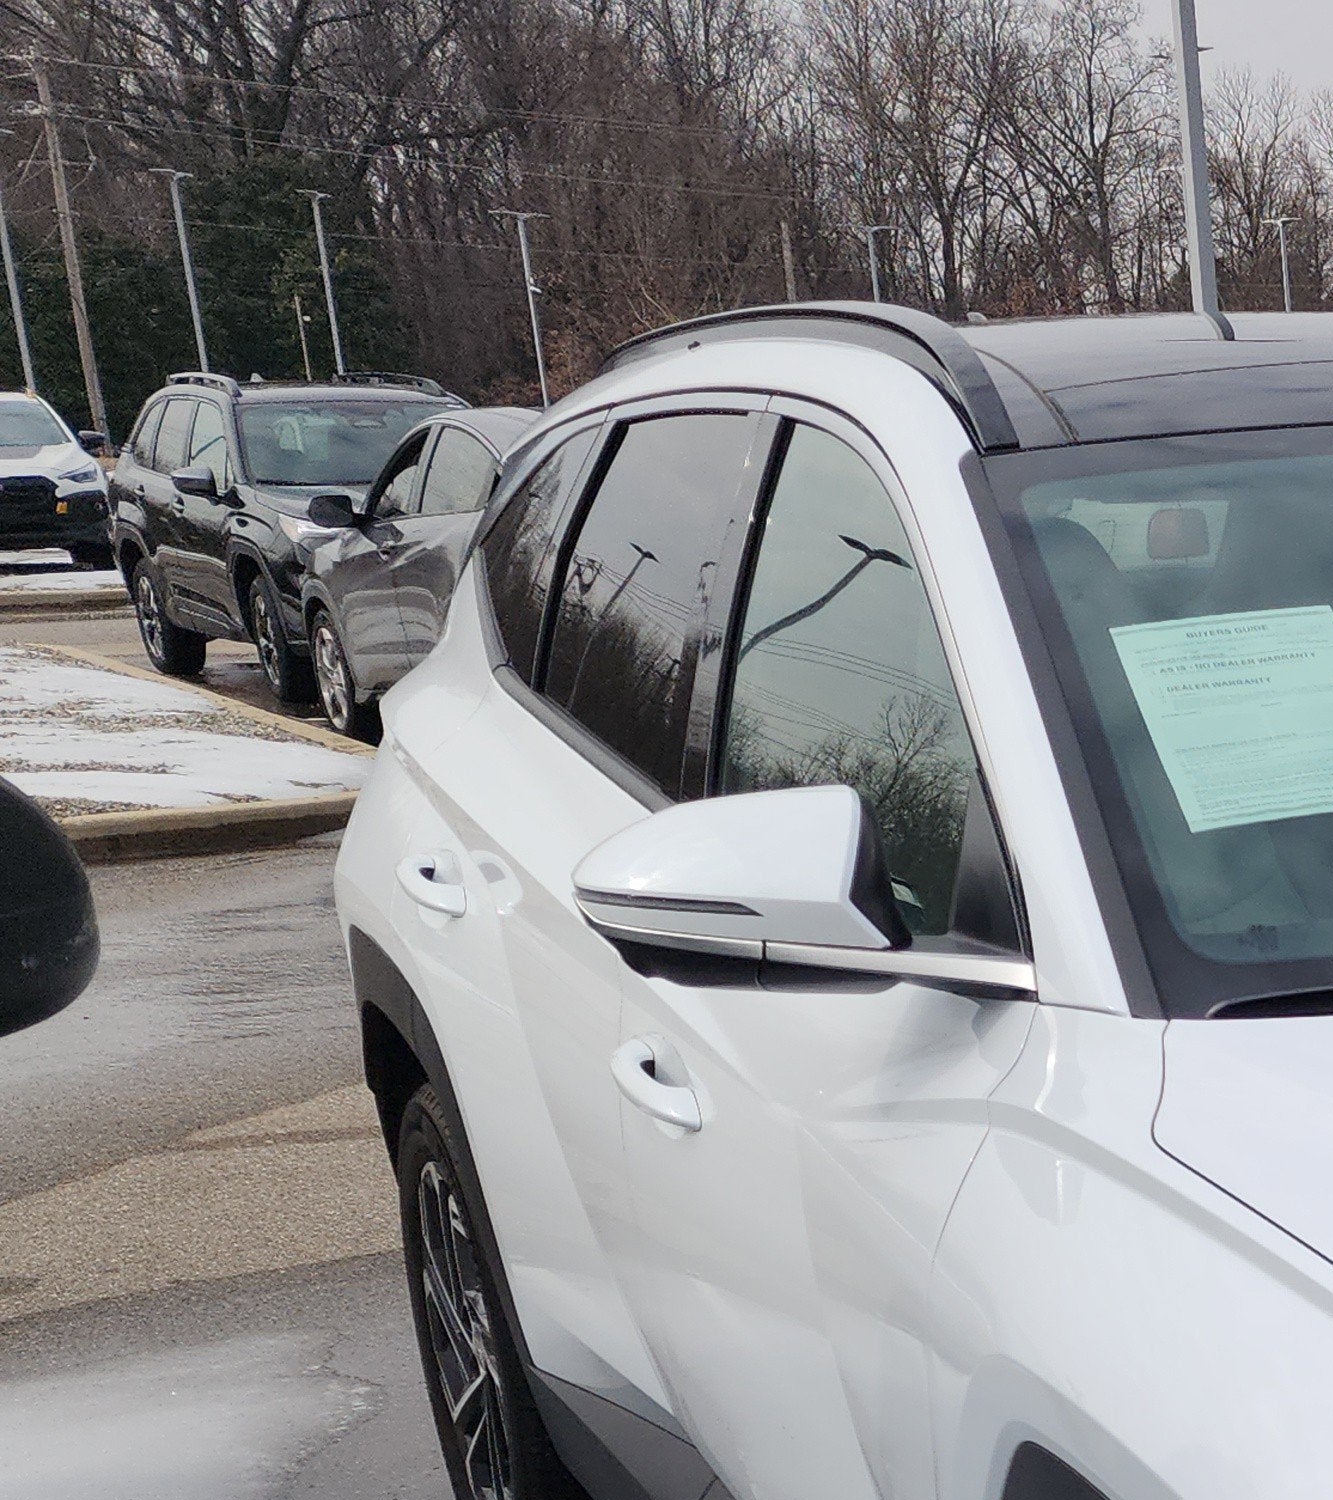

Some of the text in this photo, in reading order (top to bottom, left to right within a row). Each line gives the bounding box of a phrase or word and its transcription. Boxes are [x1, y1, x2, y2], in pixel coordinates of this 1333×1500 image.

[1186, 624, 1267, 638] BUYERS GUIDE
[1213, 659, 1256, 667] DEALER
[1258, 652, 1316, 662] WARRANTY
[1167, 677, 1271, 692] DEALER WARRANTY
